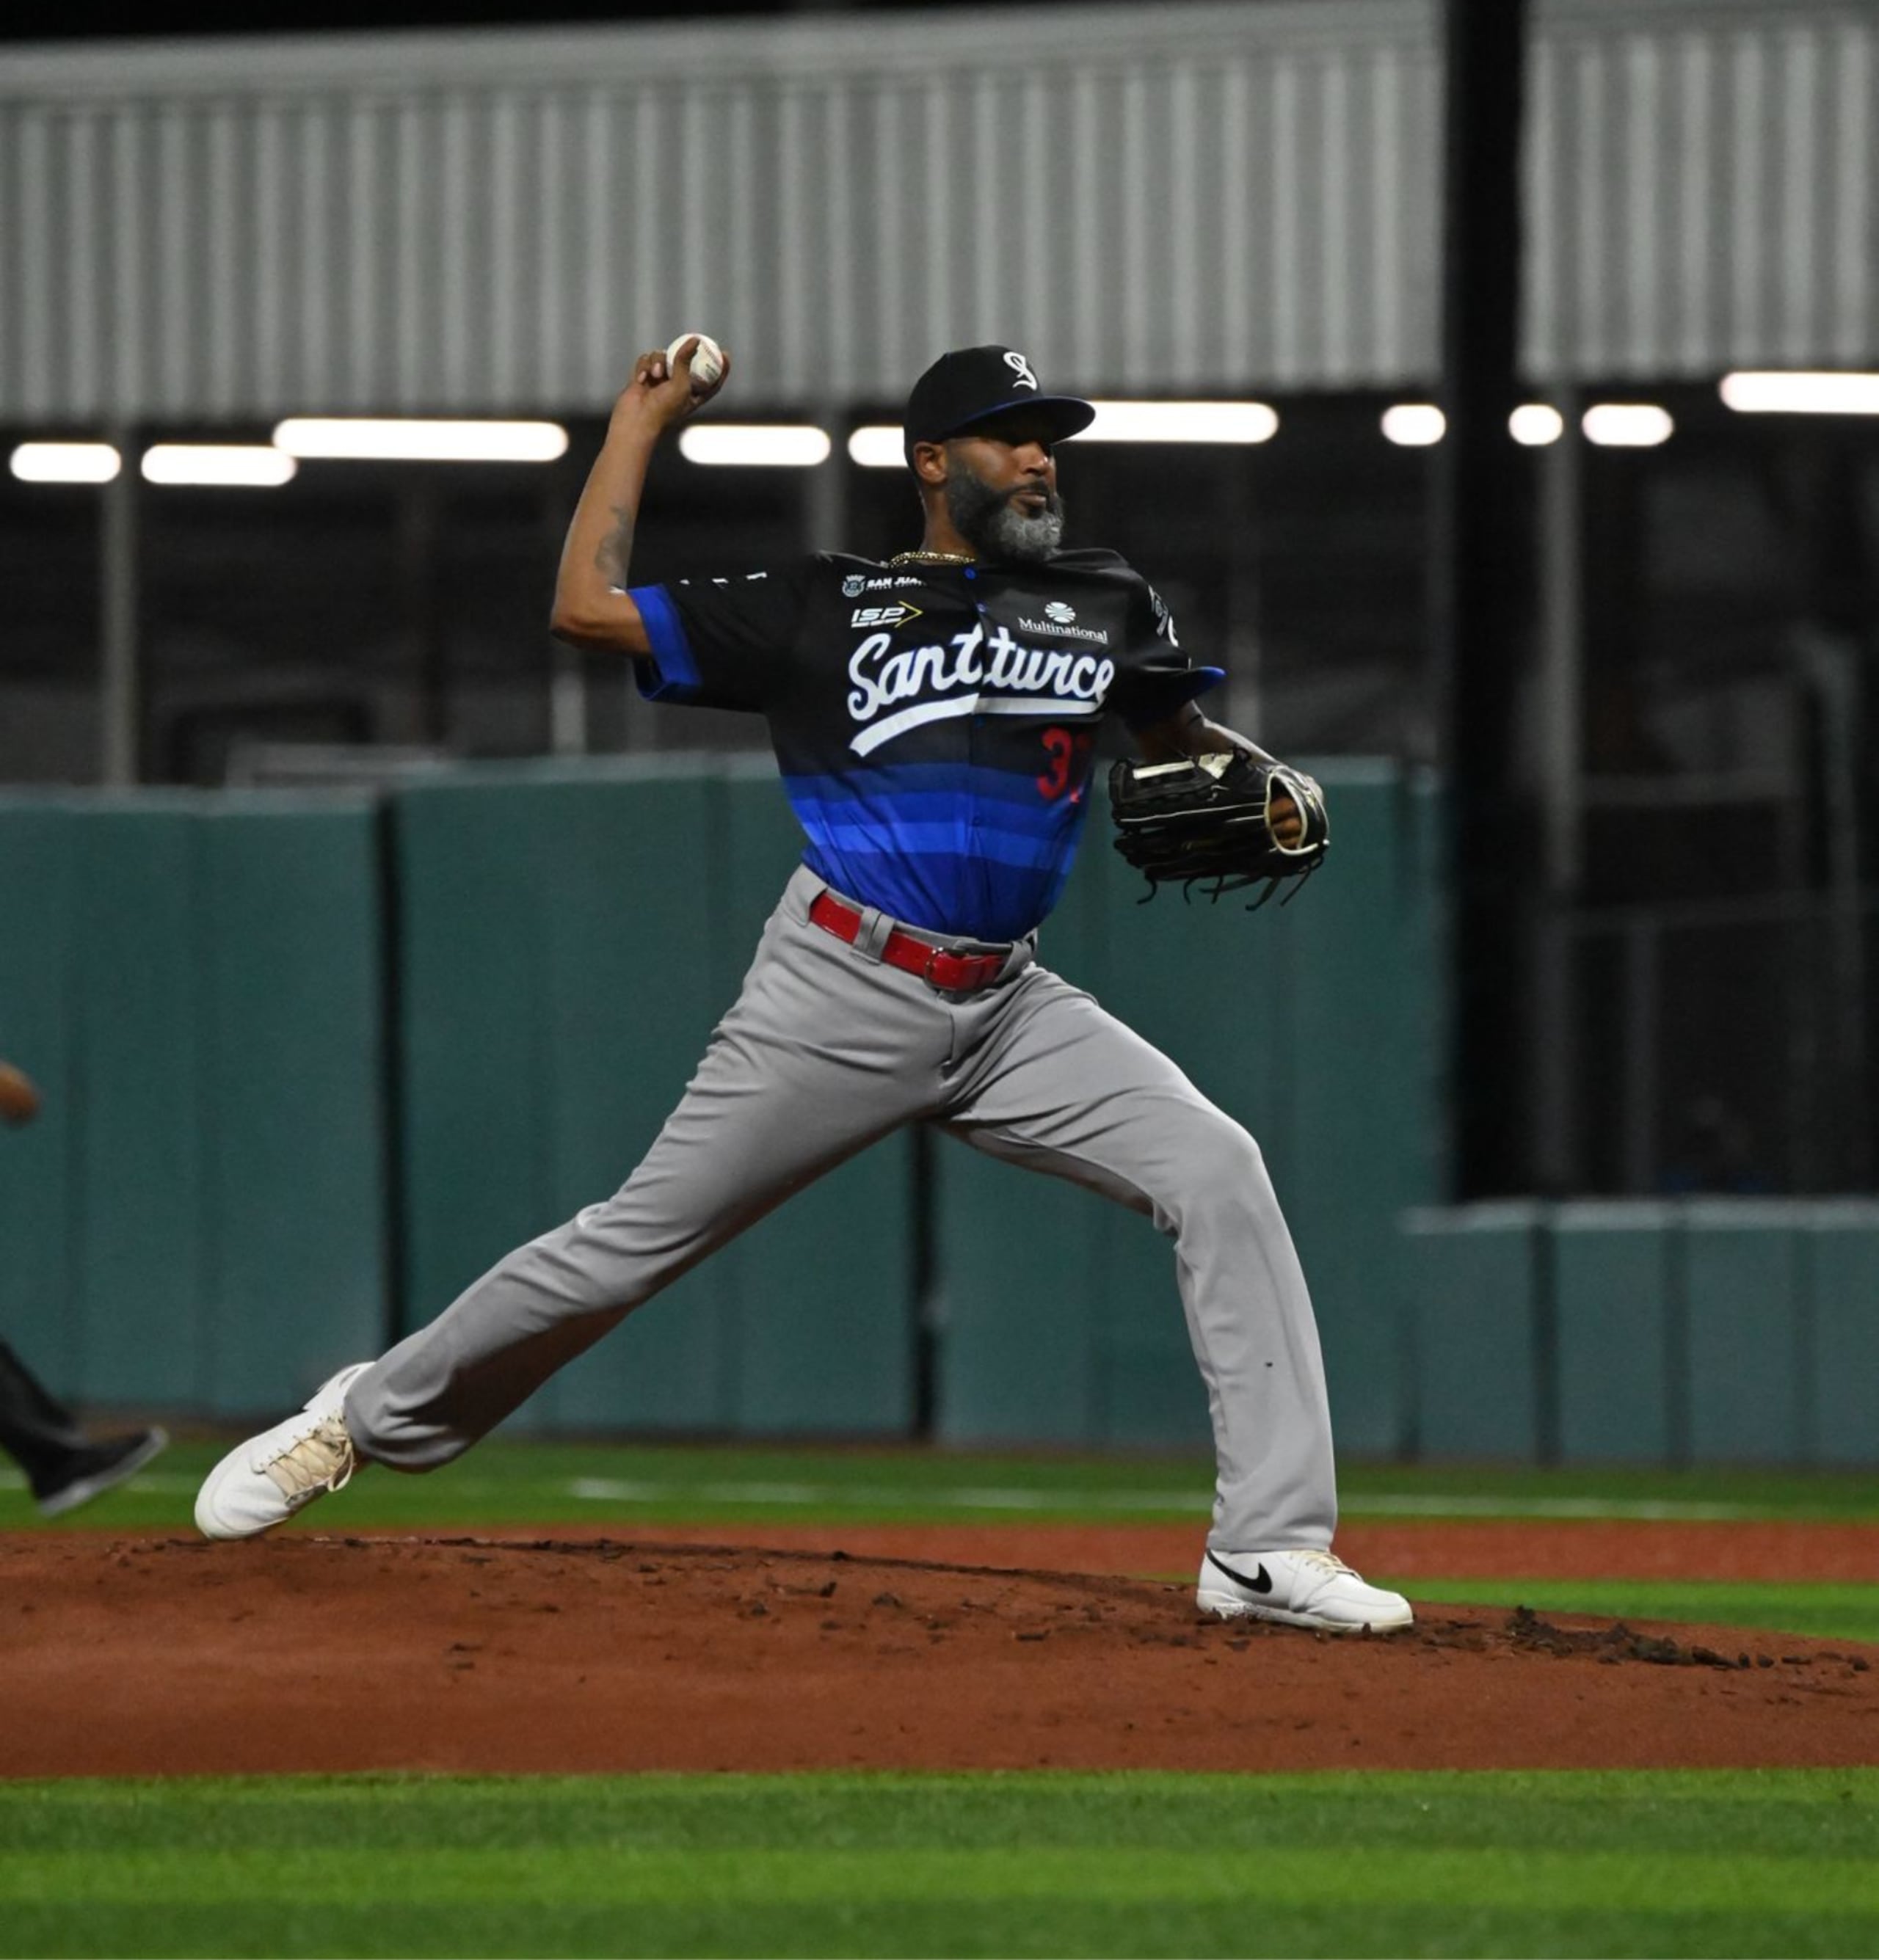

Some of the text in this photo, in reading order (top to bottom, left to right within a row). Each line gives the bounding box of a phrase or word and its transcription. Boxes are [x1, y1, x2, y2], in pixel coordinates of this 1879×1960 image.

[867, 576, 923, 589] SAN JUA
[851, 607, 906, 625] ISP
[1018, 617, 1108, 642] Multinational
[1037, 727, 1091, 805] 3
